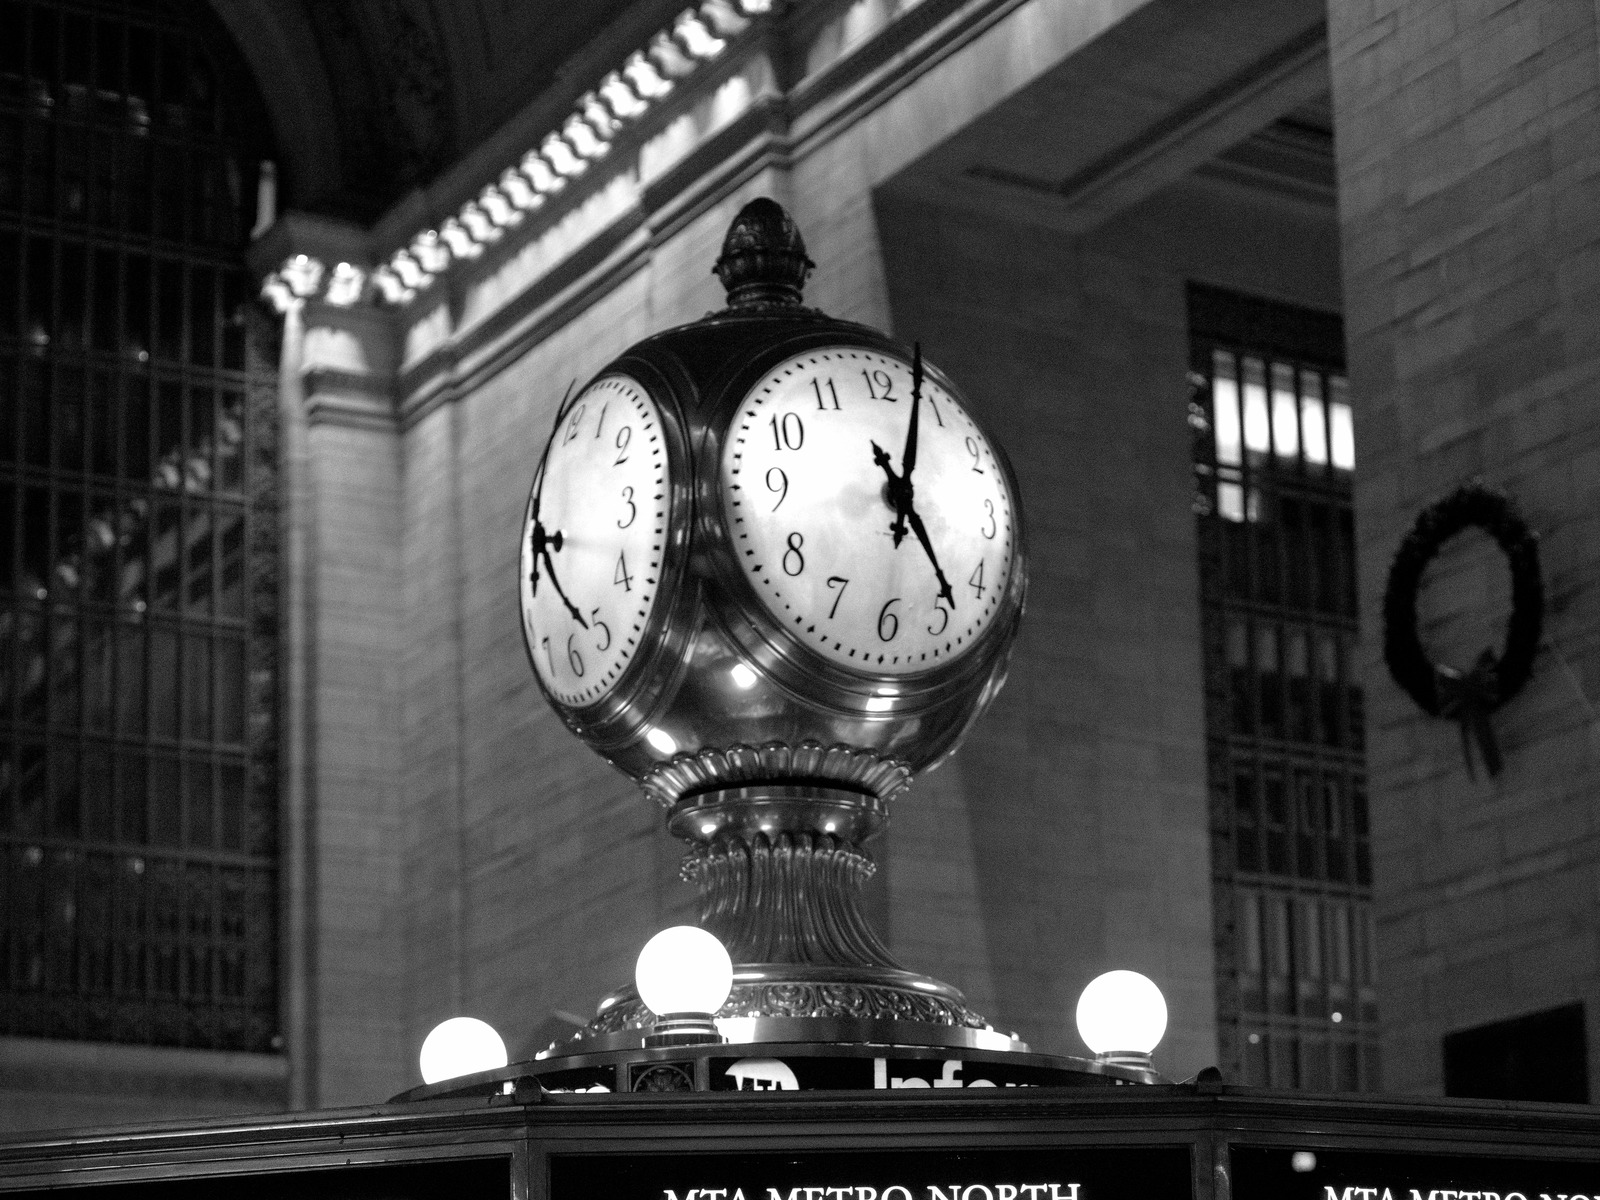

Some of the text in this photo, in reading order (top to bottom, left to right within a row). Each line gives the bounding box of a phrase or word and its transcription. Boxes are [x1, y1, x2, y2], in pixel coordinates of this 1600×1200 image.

[809, 376, 846, 413] 11
[860, 367, 900, 404] 12
[594, 399, 609, 440] 1
[768, 411, 806, 453] 10
[929, 393, 948, 430] 1
[611, 425, 633, 467] 2
[964, 435, 987, 477] 2
[616, 485, 637, 530] 3
[764, 464, 790, 514] 9
[980, 497, 999, 541] 3
[613, 548, 634, 593] 4
[782, 531, 806, 578] 8
[826, 574, 852, 620] 7
[967, 557, 988, 601] 4
[591, 607, 612, 653] 5
[877, 597, 902, 643] 6
[925, 601, 950, 637] 5
[566, 632, 586, 679] 6
